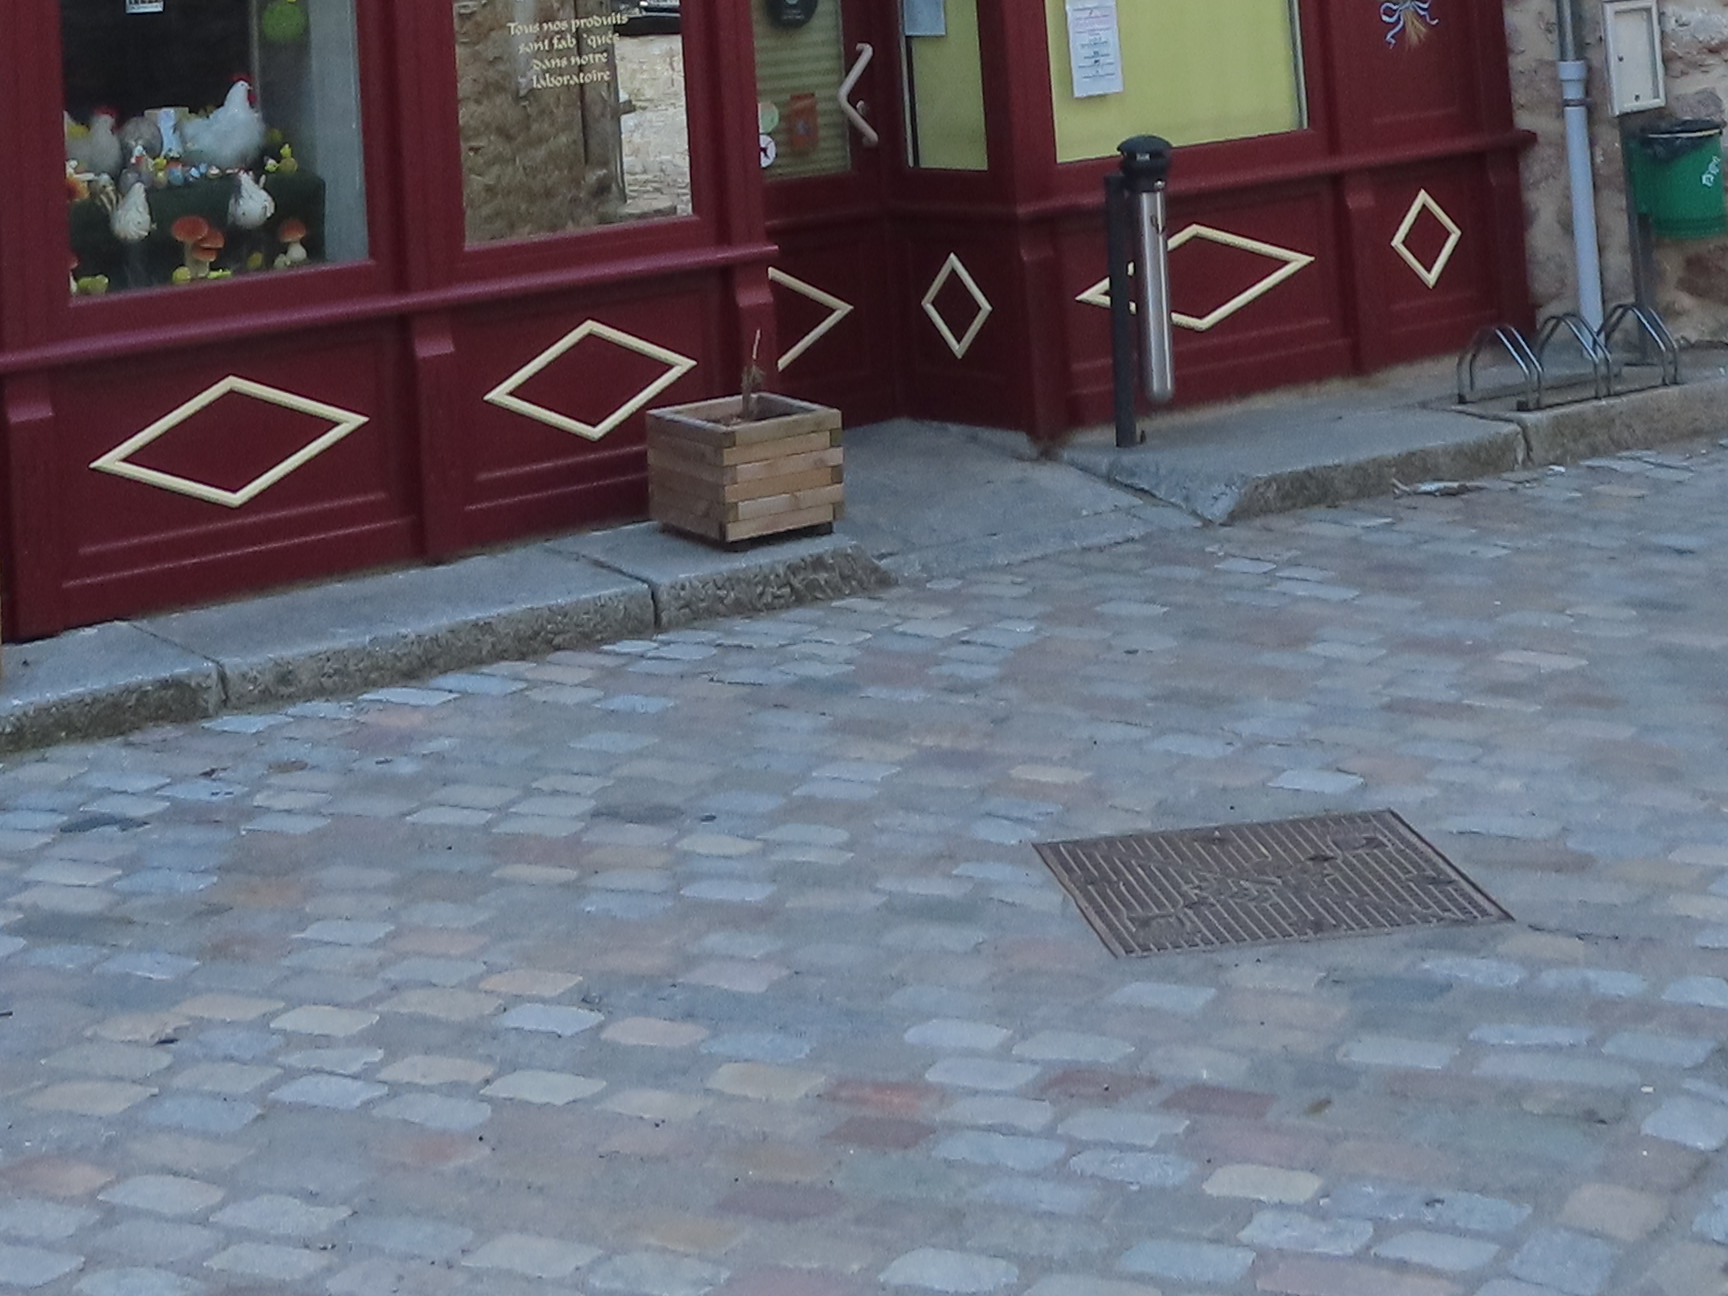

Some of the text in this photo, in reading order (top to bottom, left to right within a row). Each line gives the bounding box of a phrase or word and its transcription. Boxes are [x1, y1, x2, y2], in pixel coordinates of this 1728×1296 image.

[506, 12, 630, 36] Tous nos produits
[570, 52, 608, 66] notre
[532, 70, 611, 89] laboratoire
